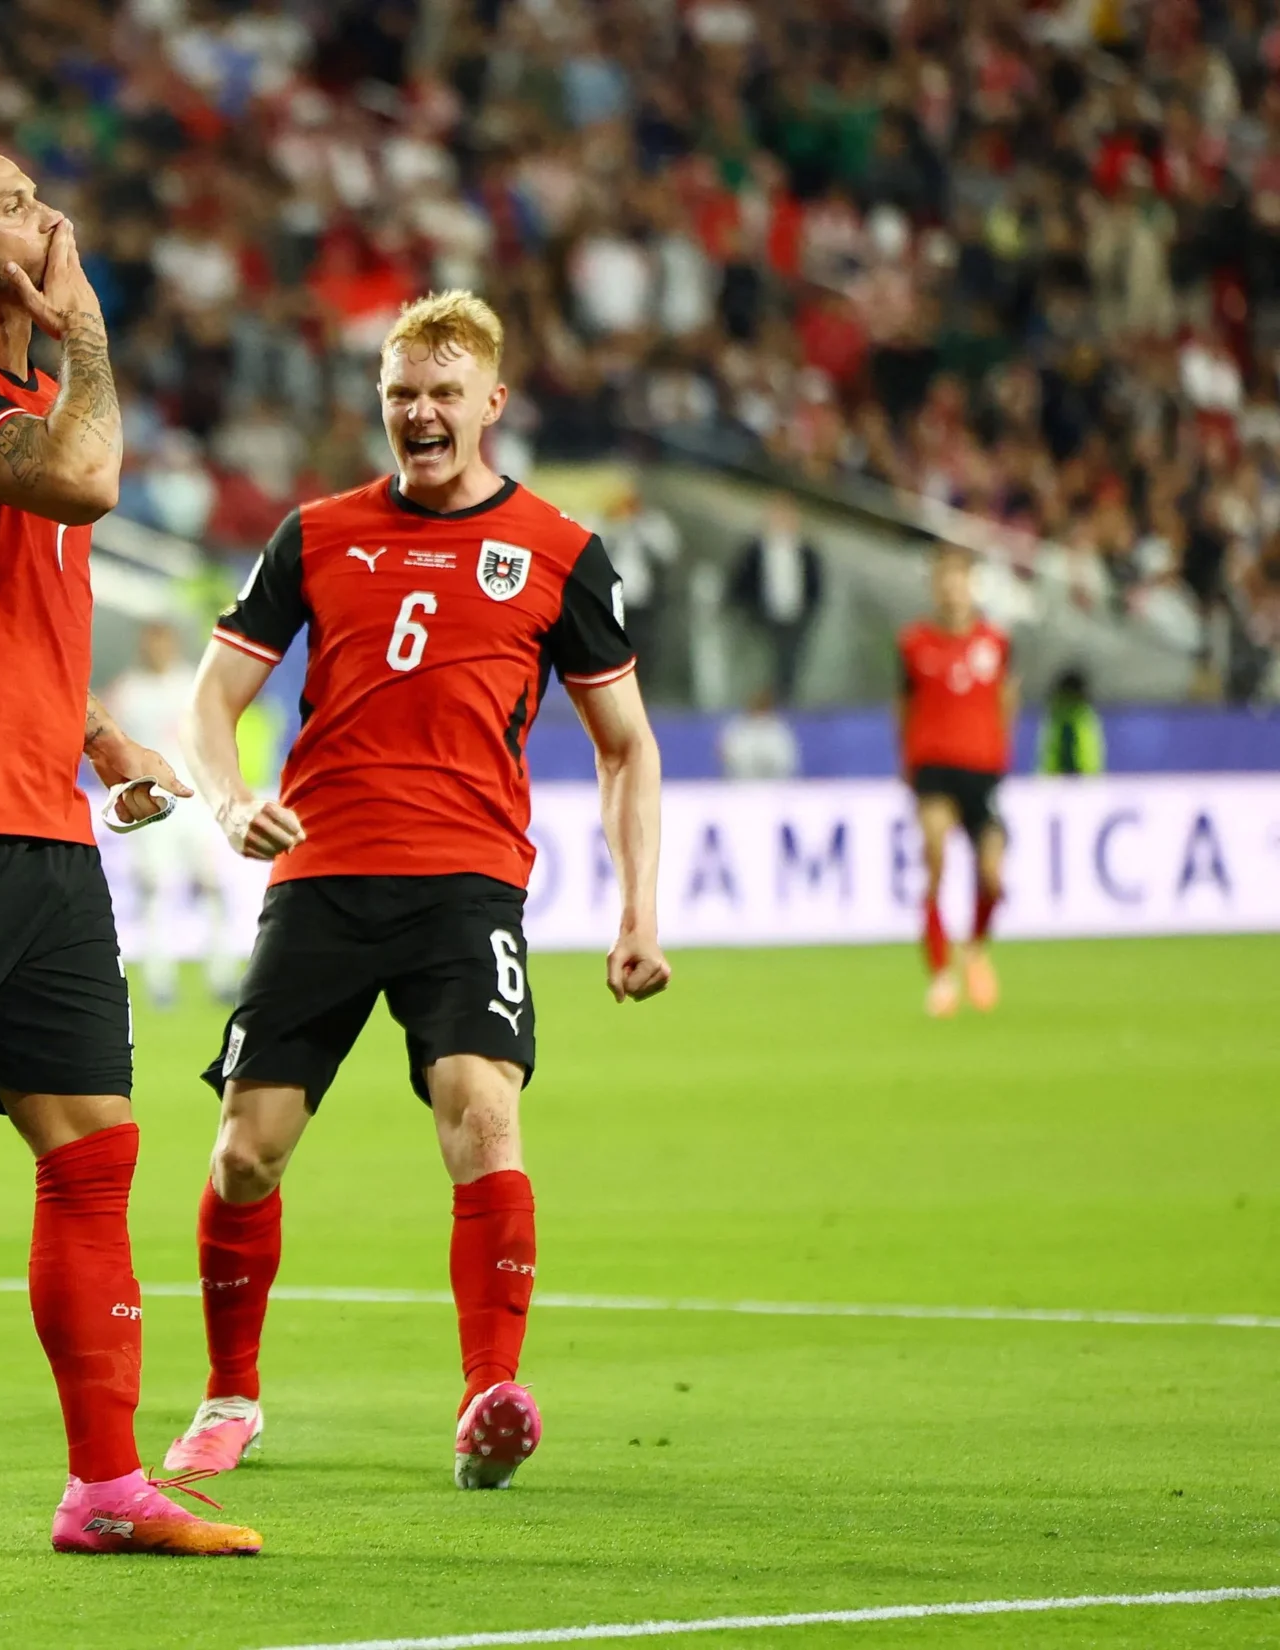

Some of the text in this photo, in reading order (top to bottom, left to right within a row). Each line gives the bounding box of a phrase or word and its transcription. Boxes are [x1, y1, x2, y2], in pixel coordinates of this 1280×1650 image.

[386, 590, 439, 672] 6
[684, 808, 1231, 910] AMEICA
[489, 928, 525, 1004] 6
[110, 1302, 143, 1321] ÖF
